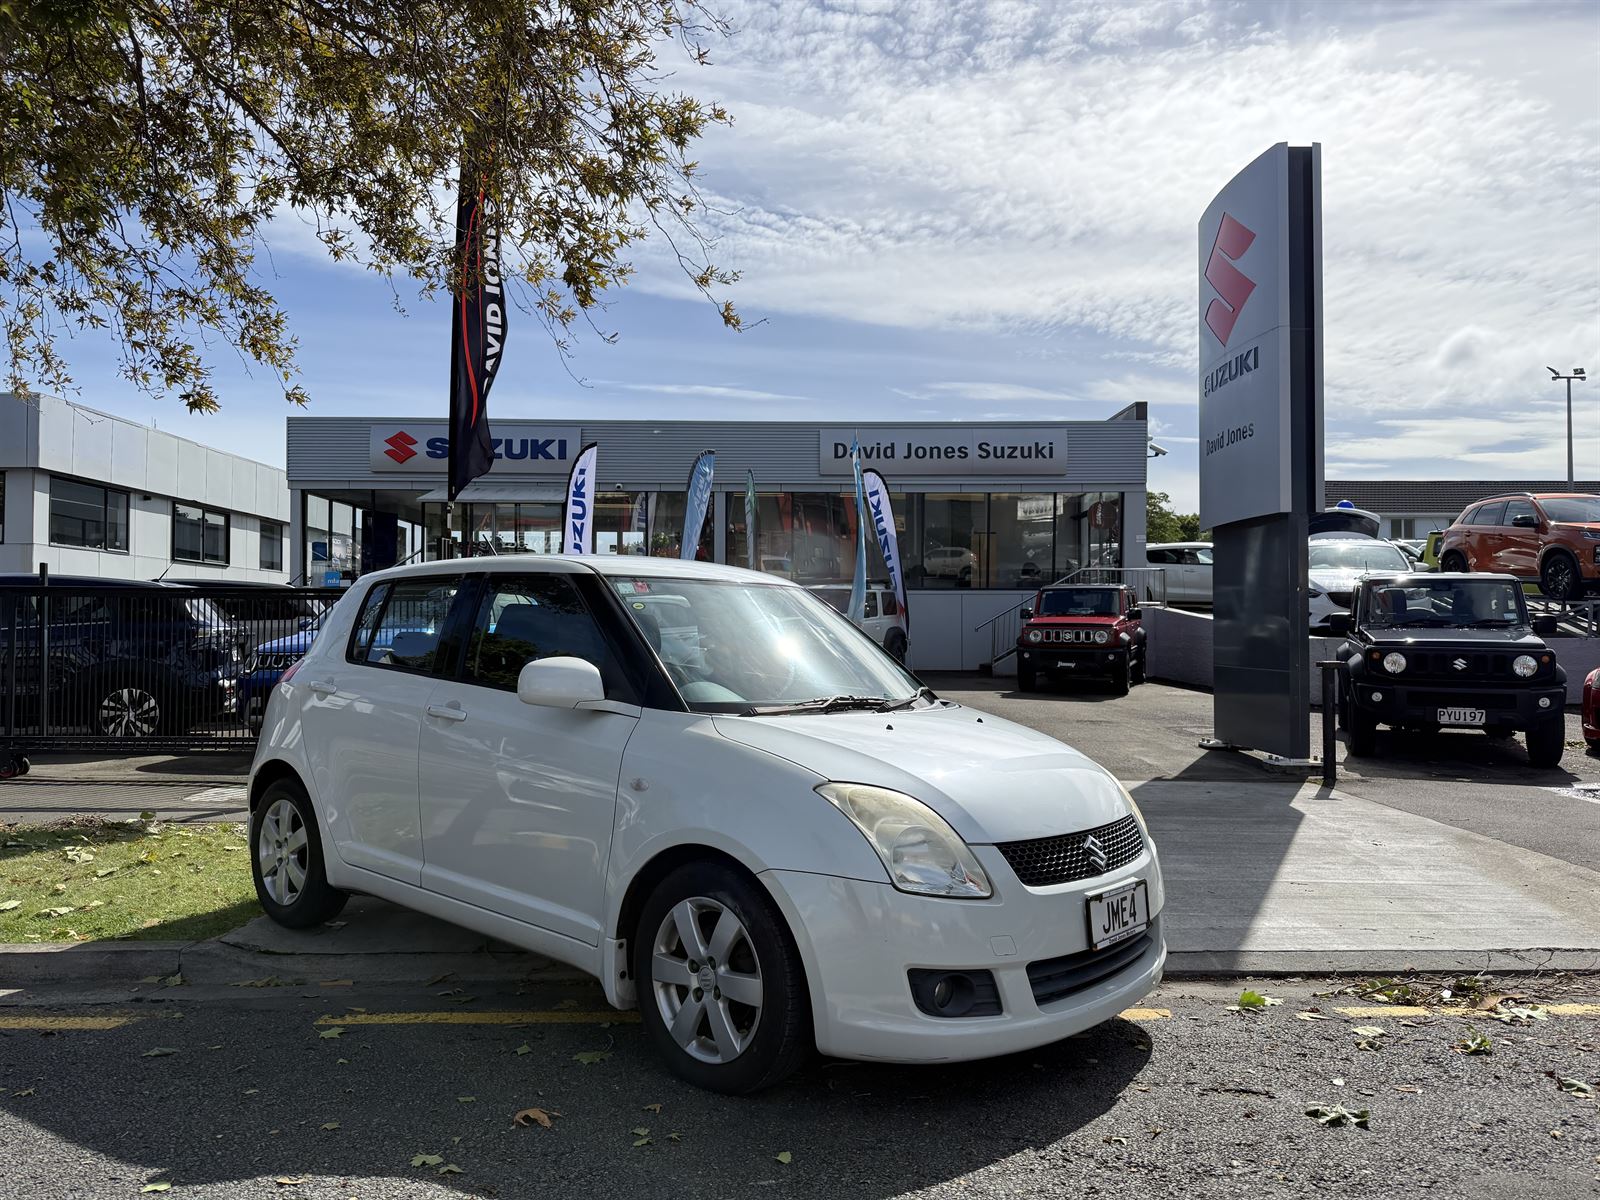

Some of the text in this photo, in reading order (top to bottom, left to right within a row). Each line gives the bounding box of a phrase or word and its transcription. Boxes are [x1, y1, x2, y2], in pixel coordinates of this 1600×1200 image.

[1204, 345, 1259, 398] SUZUKI
[425, 437, 567, 460] SZUKI
[903, 442, 969, 460] Jones
[977, 441, 1054, 460] Suzuki
[1206, 422, 1255, 457] David Jones
[1438, 710, 1485, 722] PYU197
[1102, 892, 1137, 934] JME4
